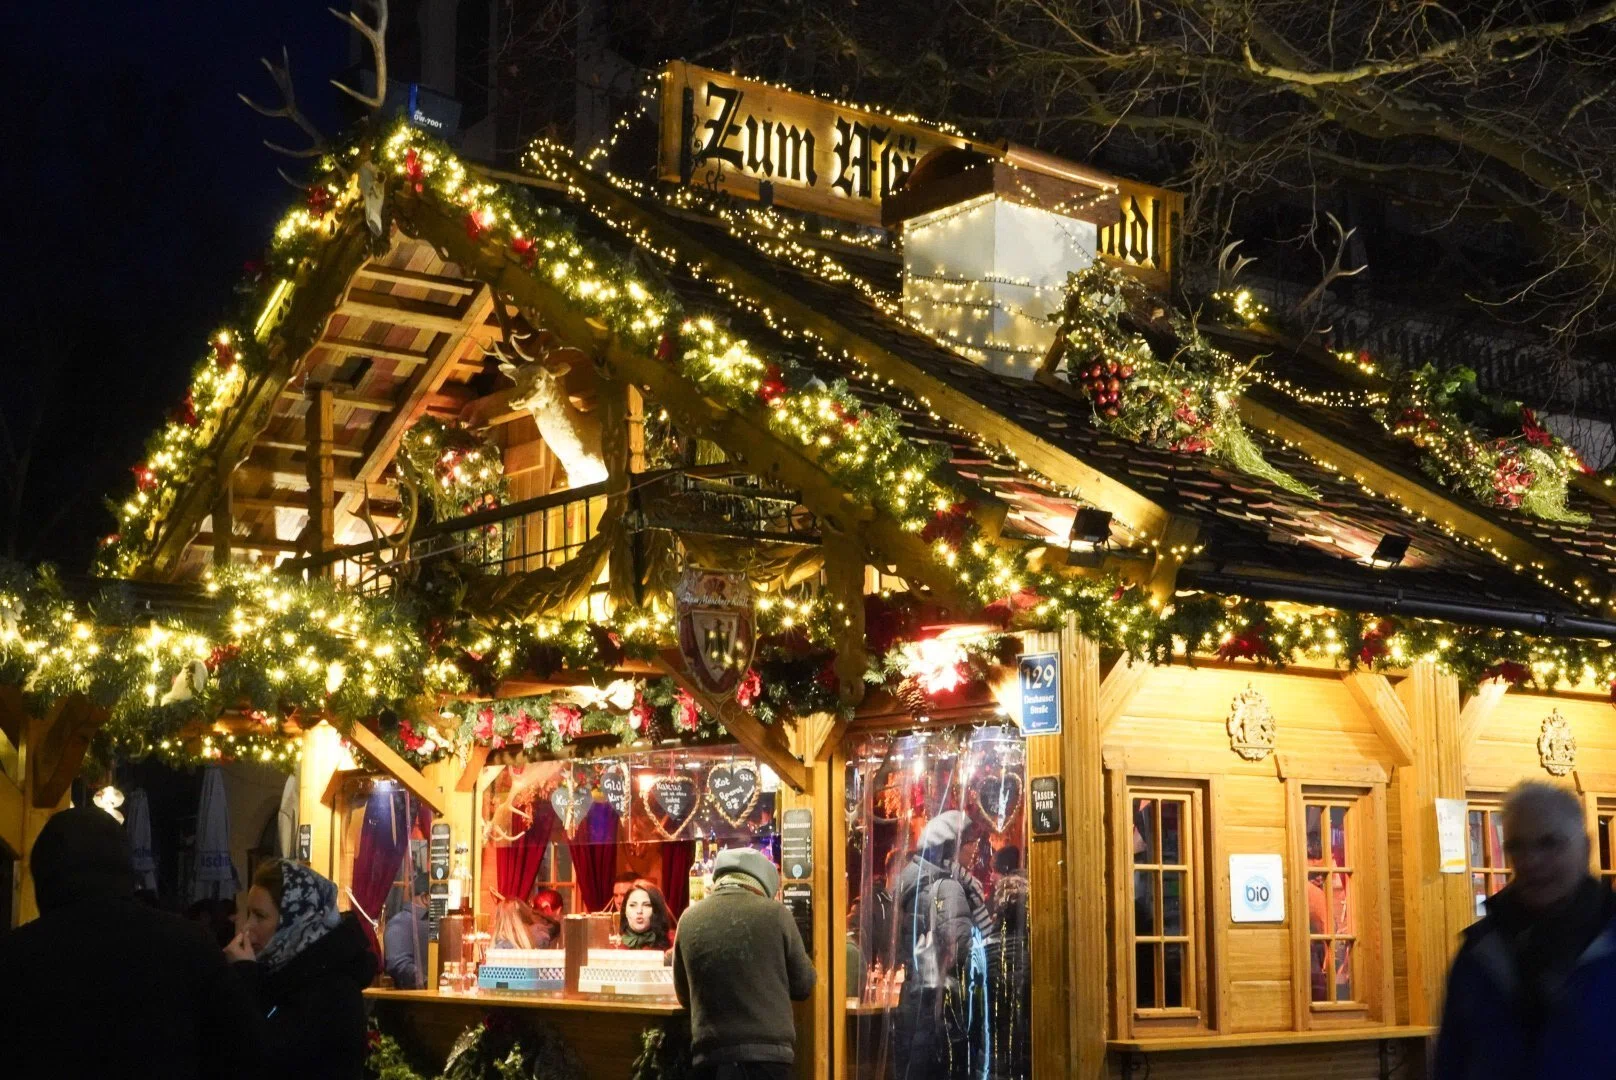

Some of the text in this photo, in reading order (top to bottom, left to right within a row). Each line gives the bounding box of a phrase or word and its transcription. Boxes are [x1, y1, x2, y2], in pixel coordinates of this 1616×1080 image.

[704, 81, 817, 187] Zum
[1024, 664, 1055, 690] 129
[1035, 799, 1054, 810] PFAND
[1245, 885, 1270, 902] bio
